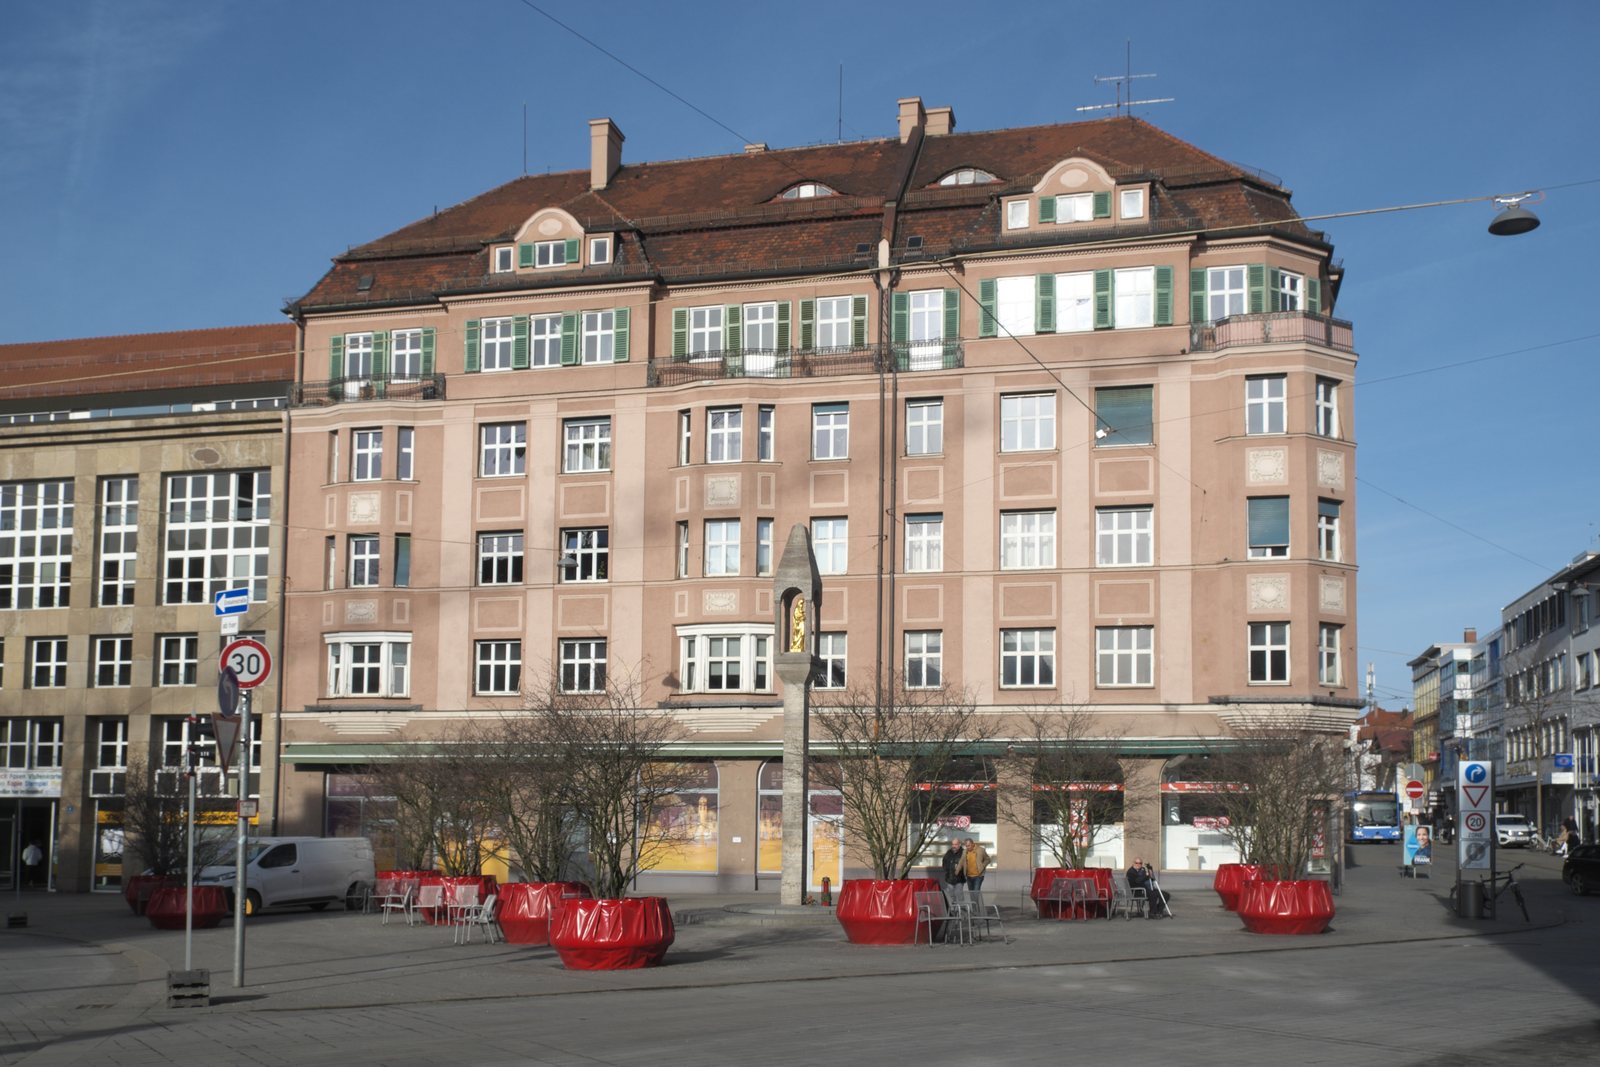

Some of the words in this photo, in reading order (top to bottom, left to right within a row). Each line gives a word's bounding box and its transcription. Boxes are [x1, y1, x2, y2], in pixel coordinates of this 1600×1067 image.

[232, 653, 260, 675] 30
[1470, 817, 1482, 827] 20
[1312, 847, 1325, 855] SALE
